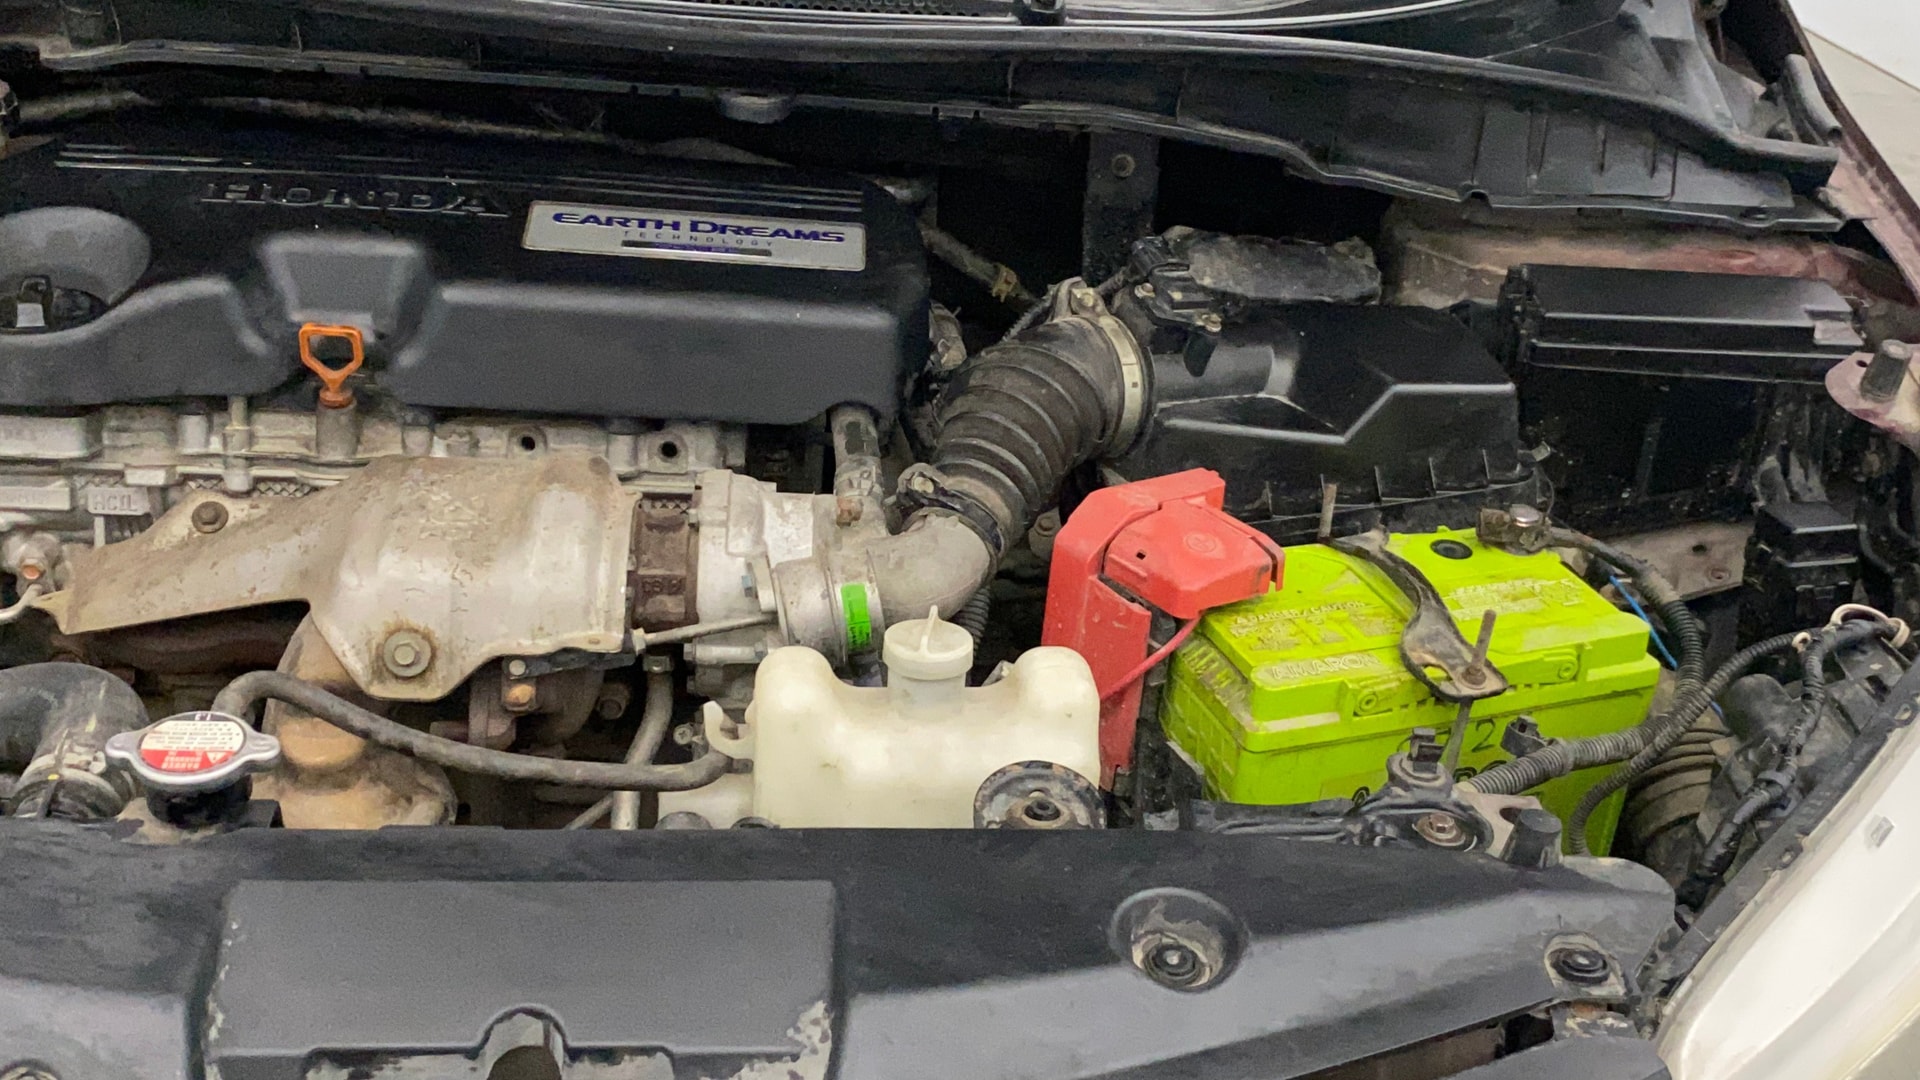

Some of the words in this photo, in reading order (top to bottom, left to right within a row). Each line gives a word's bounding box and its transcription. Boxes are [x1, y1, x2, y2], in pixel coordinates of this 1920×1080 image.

[201, 183, 508, 216] HONDA
[552, 211, 680, 231] EARTH
[689, 219, 845, 243] DREAMS
[624, 231, 774, 246] TECHNOLOGY
[1271, 653, 1380, 679] AMARON
